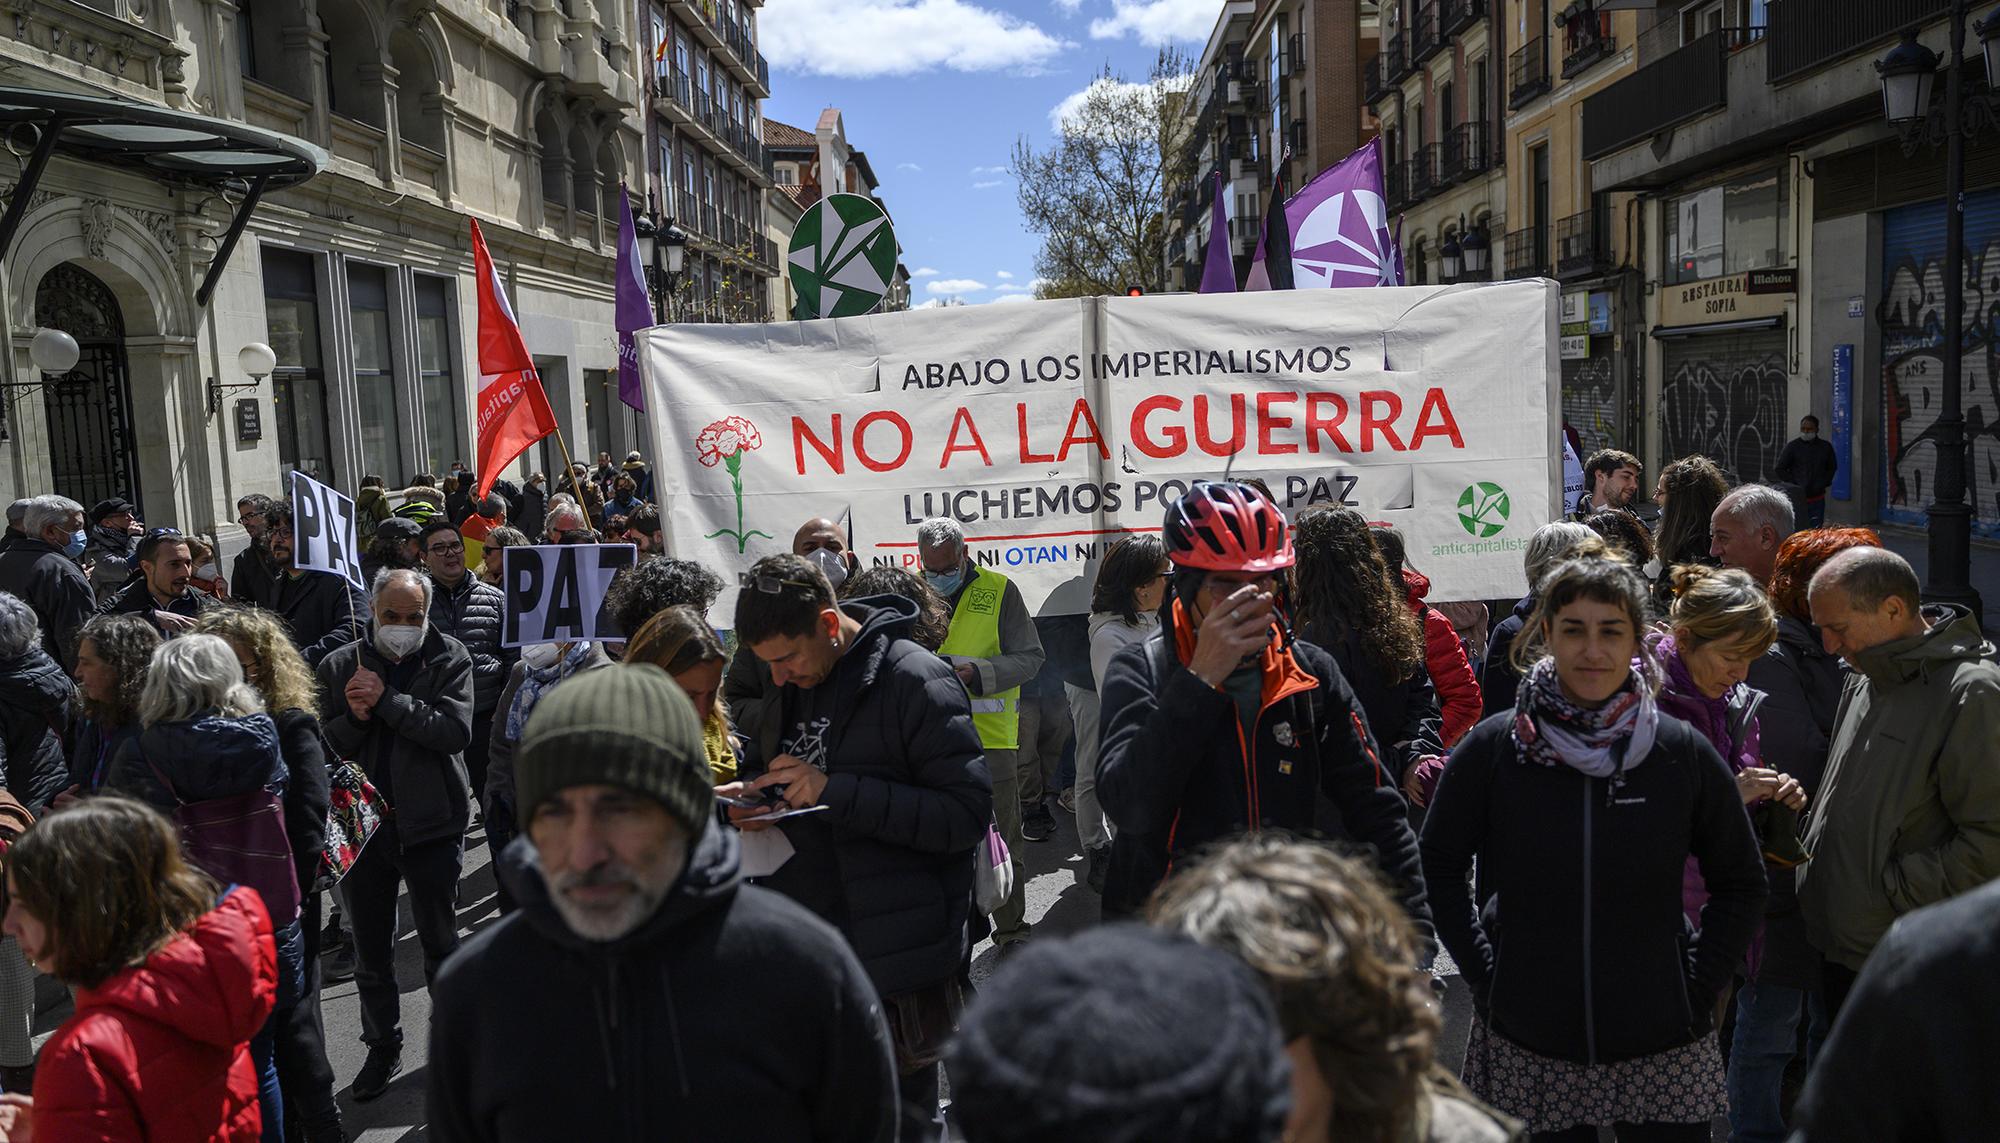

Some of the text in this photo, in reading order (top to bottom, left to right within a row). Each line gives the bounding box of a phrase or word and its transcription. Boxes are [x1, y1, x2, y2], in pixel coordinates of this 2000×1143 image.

[1753, 273, 1792, 285] Mahou
[902, 346, 1351, 391] ABAJO LOS IMPERIALISMOS
[791, 387, 1466, 475] NO A LA GUERRA
[903, 482, 1122, 525] LUCHEMOS
[1134, 479, 1208, 512] PO
[1286, 475, 1359, 508] PAZ
[1563, 484, 1584, 493] EBLOS
[295, 474, 362, 586] PAZ
[1432, 538, 1528, 556] anticapitalista
[872, 555, 895, 568] NI
[977, 549, 1000, 567] NI
[1005, 544, 1068, 566] OTAN
[1075, 542, 1097, 561] NI
[506, 547, 634, 642] PAZ
